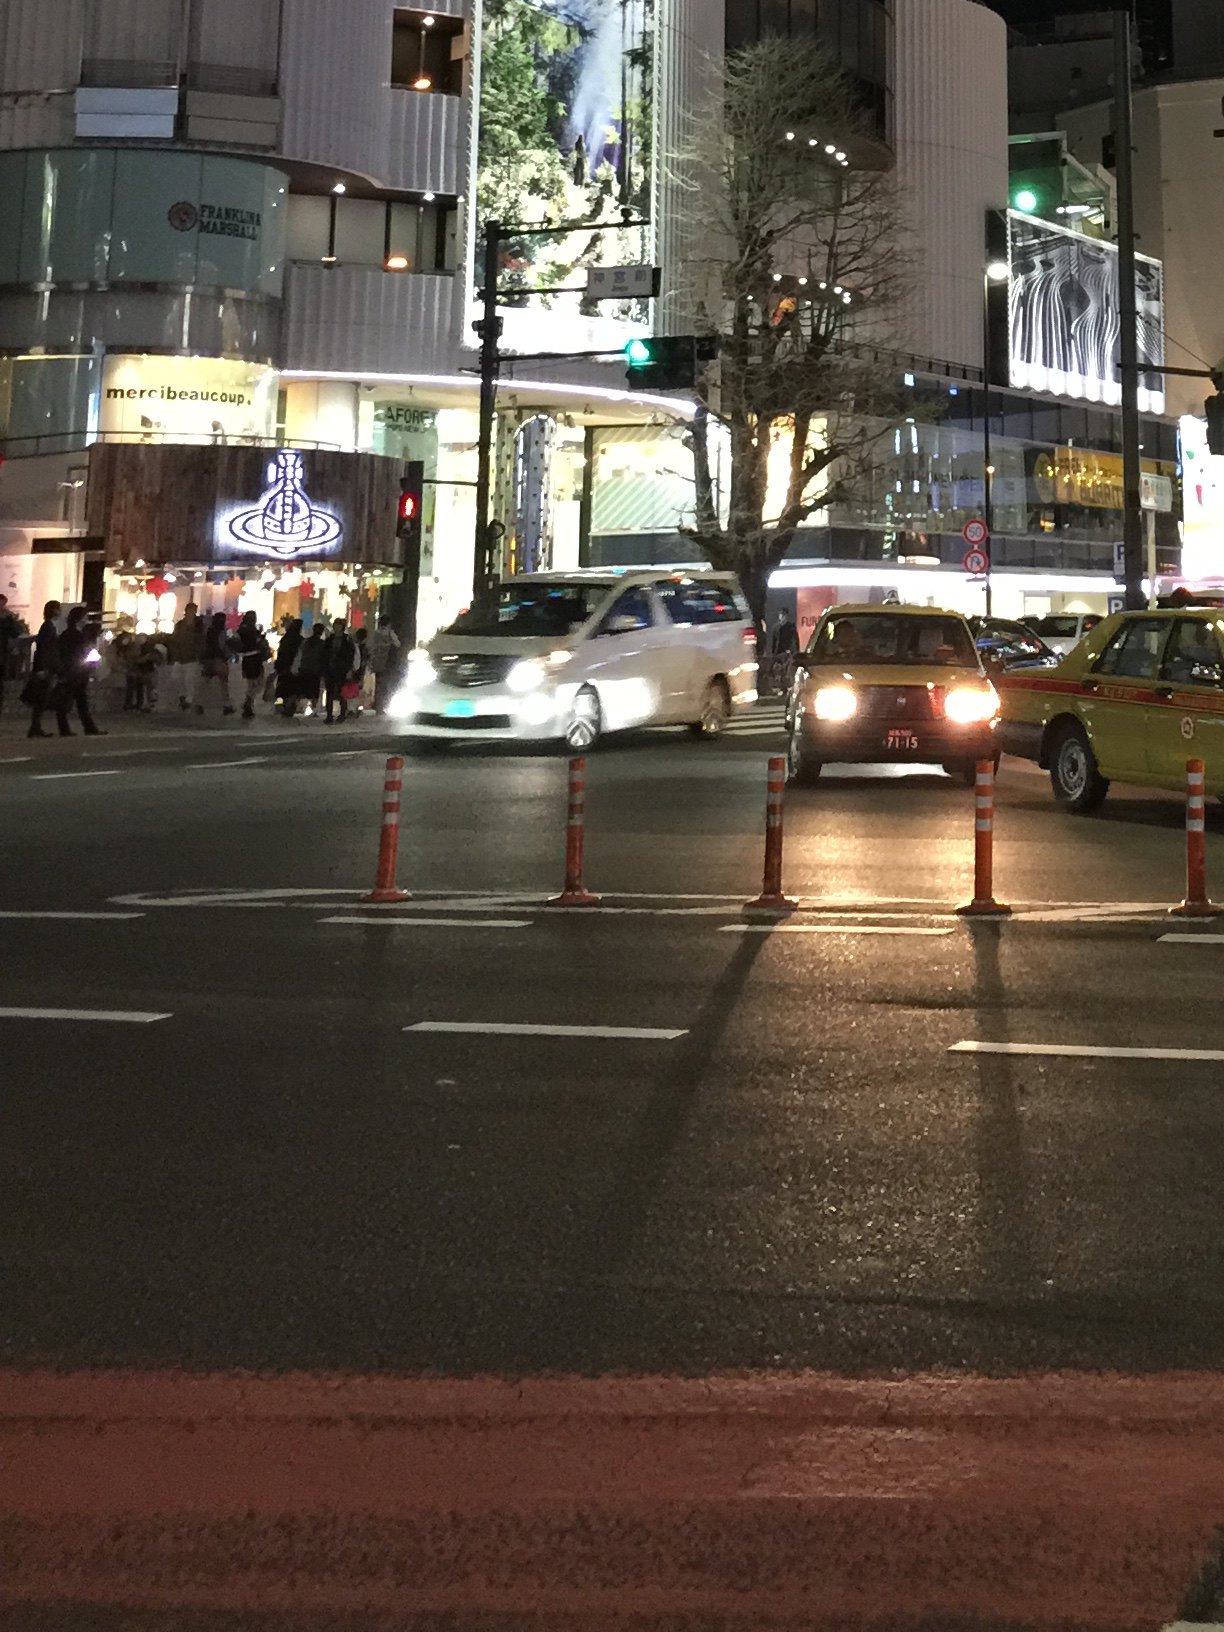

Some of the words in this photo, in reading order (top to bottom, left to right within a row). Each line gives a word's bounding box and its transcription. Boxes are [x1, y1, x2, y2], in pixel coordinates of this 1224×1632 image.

[198, 220, 257, 240] MARSHALL
[968, 525, 982, 538] 50
[1110, 599, 1123, 614] P
